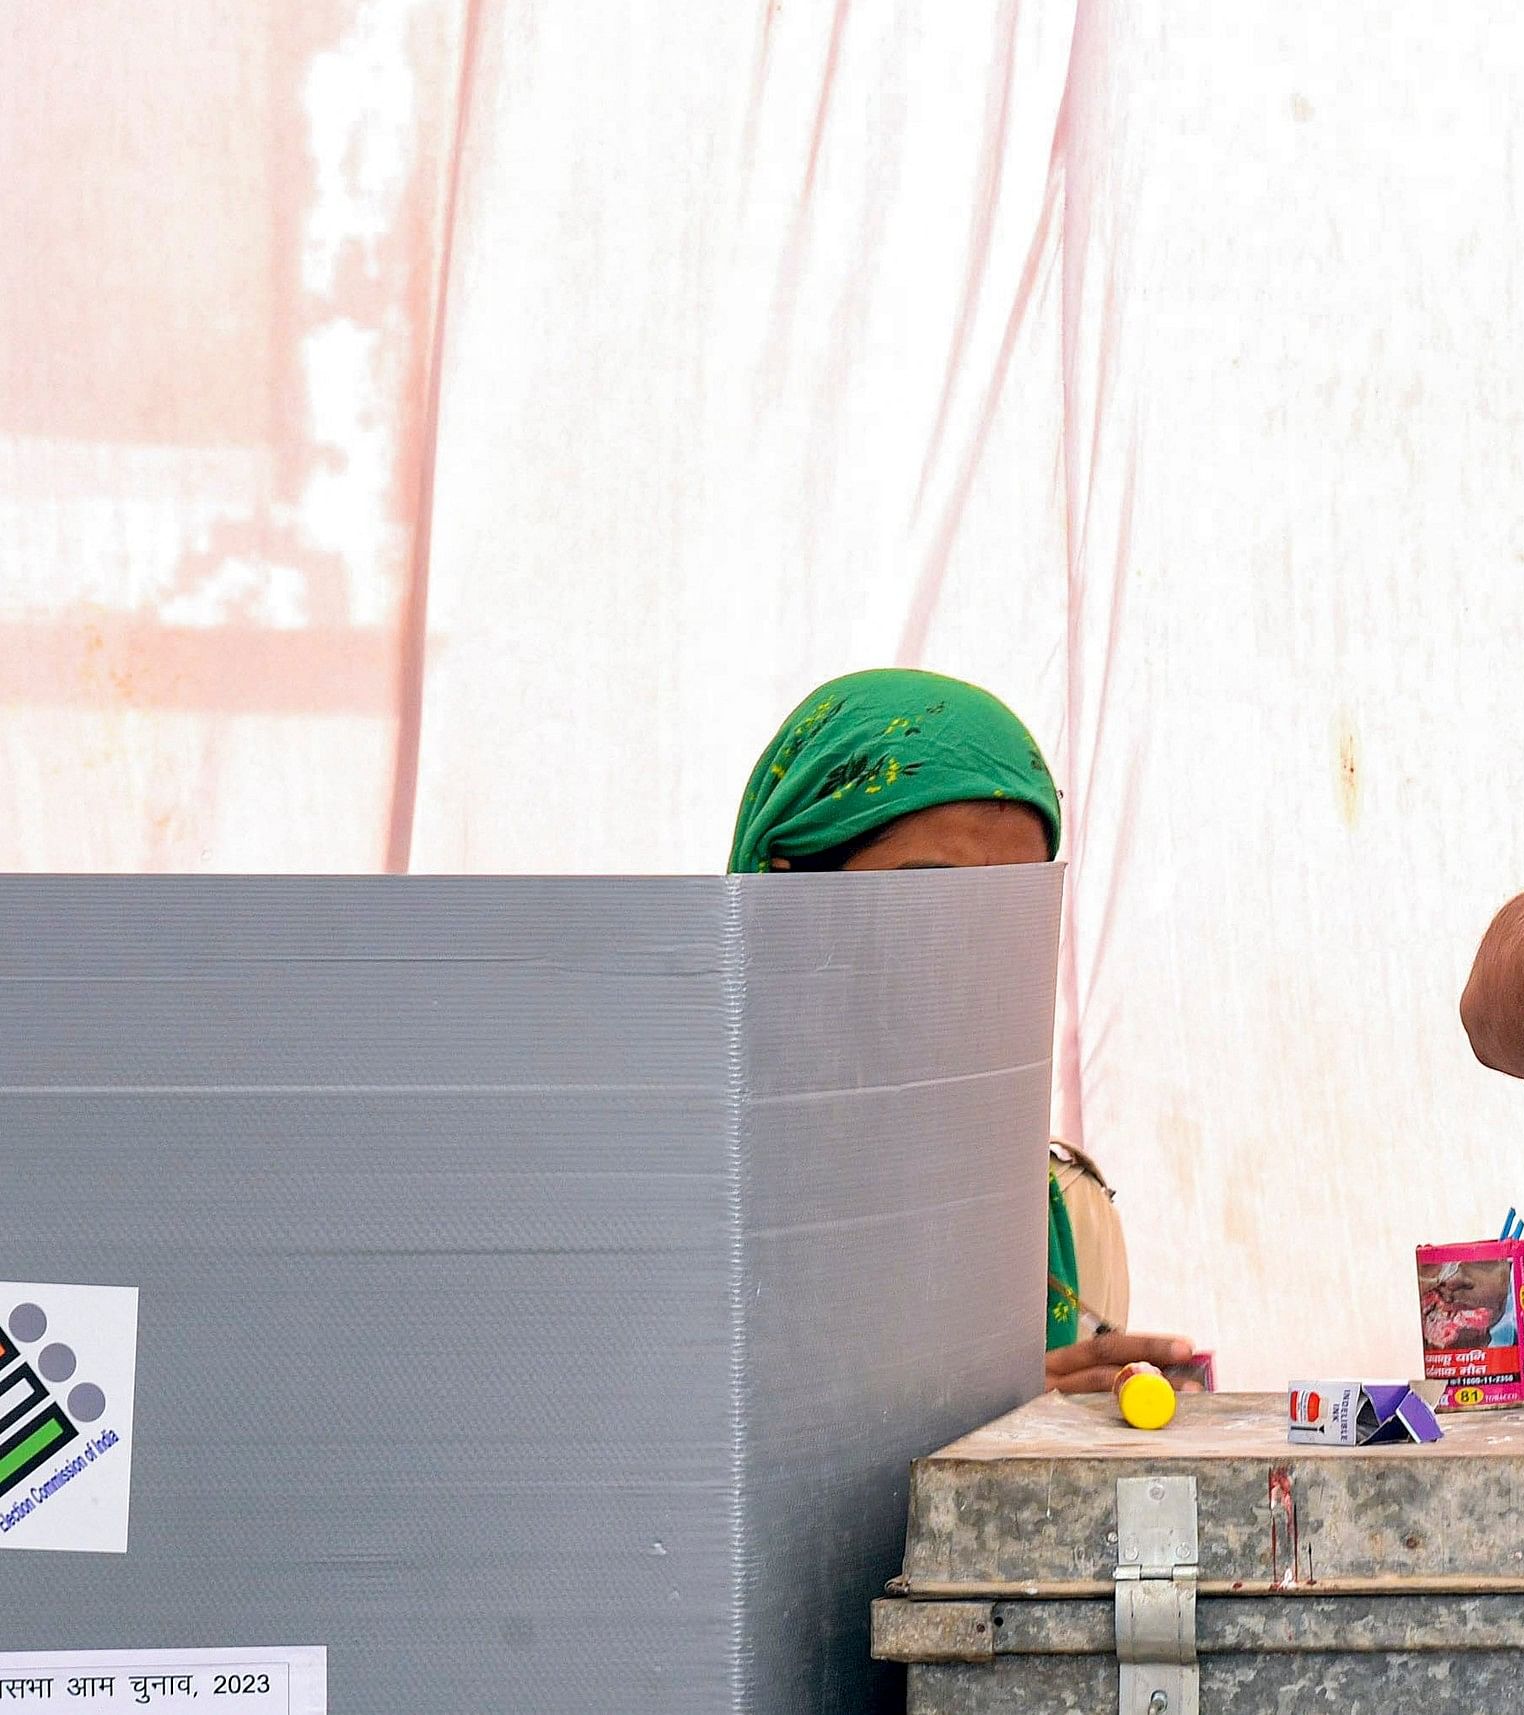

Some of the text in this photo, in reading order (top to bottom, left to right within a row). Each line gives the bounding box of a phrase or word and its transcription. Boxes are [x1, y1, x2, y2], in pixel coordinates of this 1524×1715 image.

[1461, 1390, 1478, 1402] 81
[1332, 1403, 1340, 1422] INK
[1340, 1389, 1351, 1442] INDELIBLE
[84, 1439, 98, 1461] of
[90, 1429, 119, 1455] India
[30, 1455, 88, 1503] Commission
[0, 1674, 270, 1704] सभा आम चुनाव, 2023
